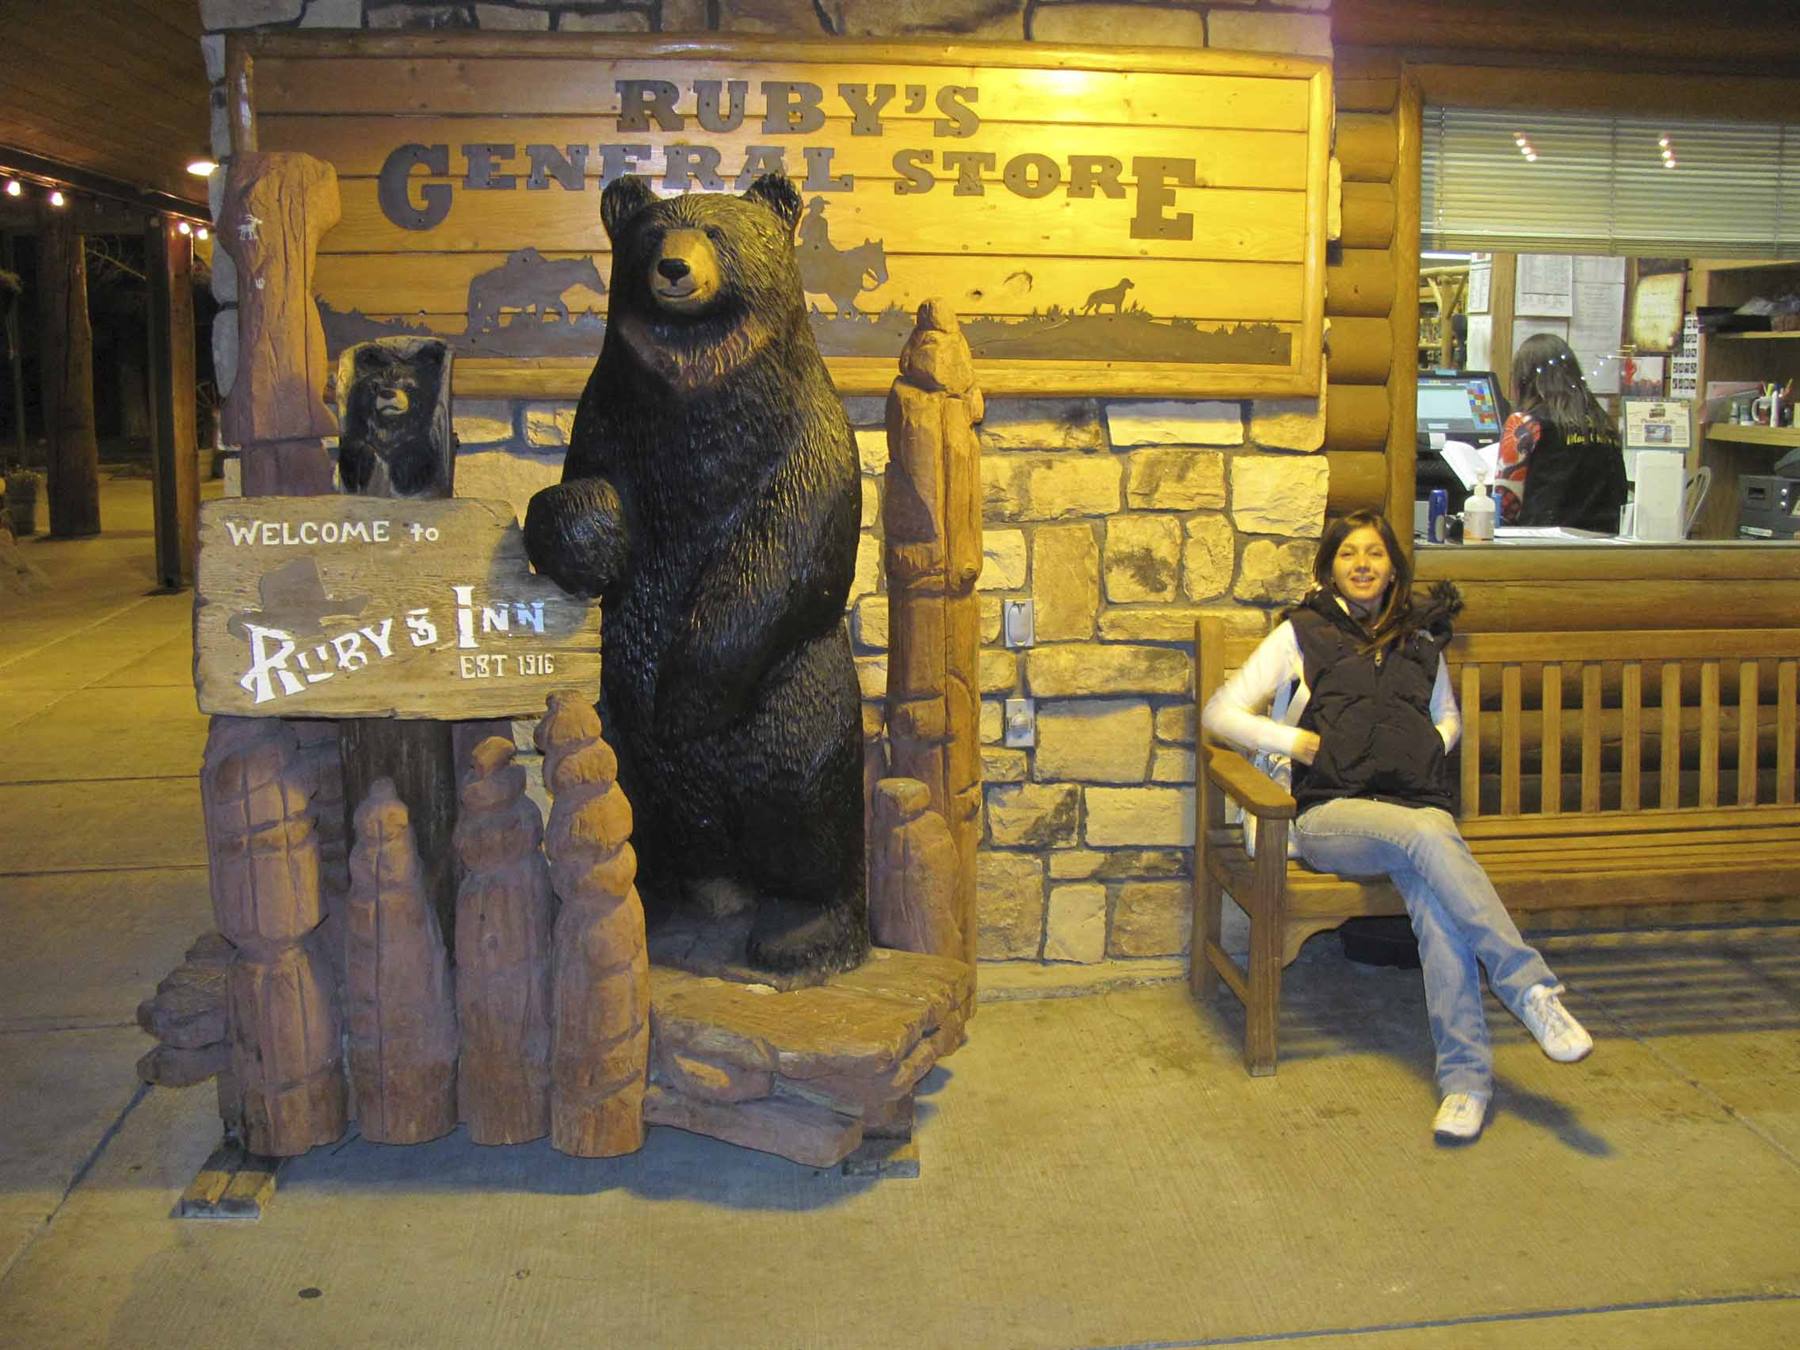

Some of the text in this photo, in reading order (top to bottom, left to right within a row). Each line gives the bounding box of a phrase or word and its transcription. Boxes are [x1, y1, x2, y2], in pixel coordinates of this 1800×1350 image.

[615, 79, 979, 138] RUBY'S
[893, 149, 1195, 241] STORE
[226, 521, 440, 546] WELCOME to
[451, 586, 545, 649] INN
[459, 654, 555, 679] EST 1916
